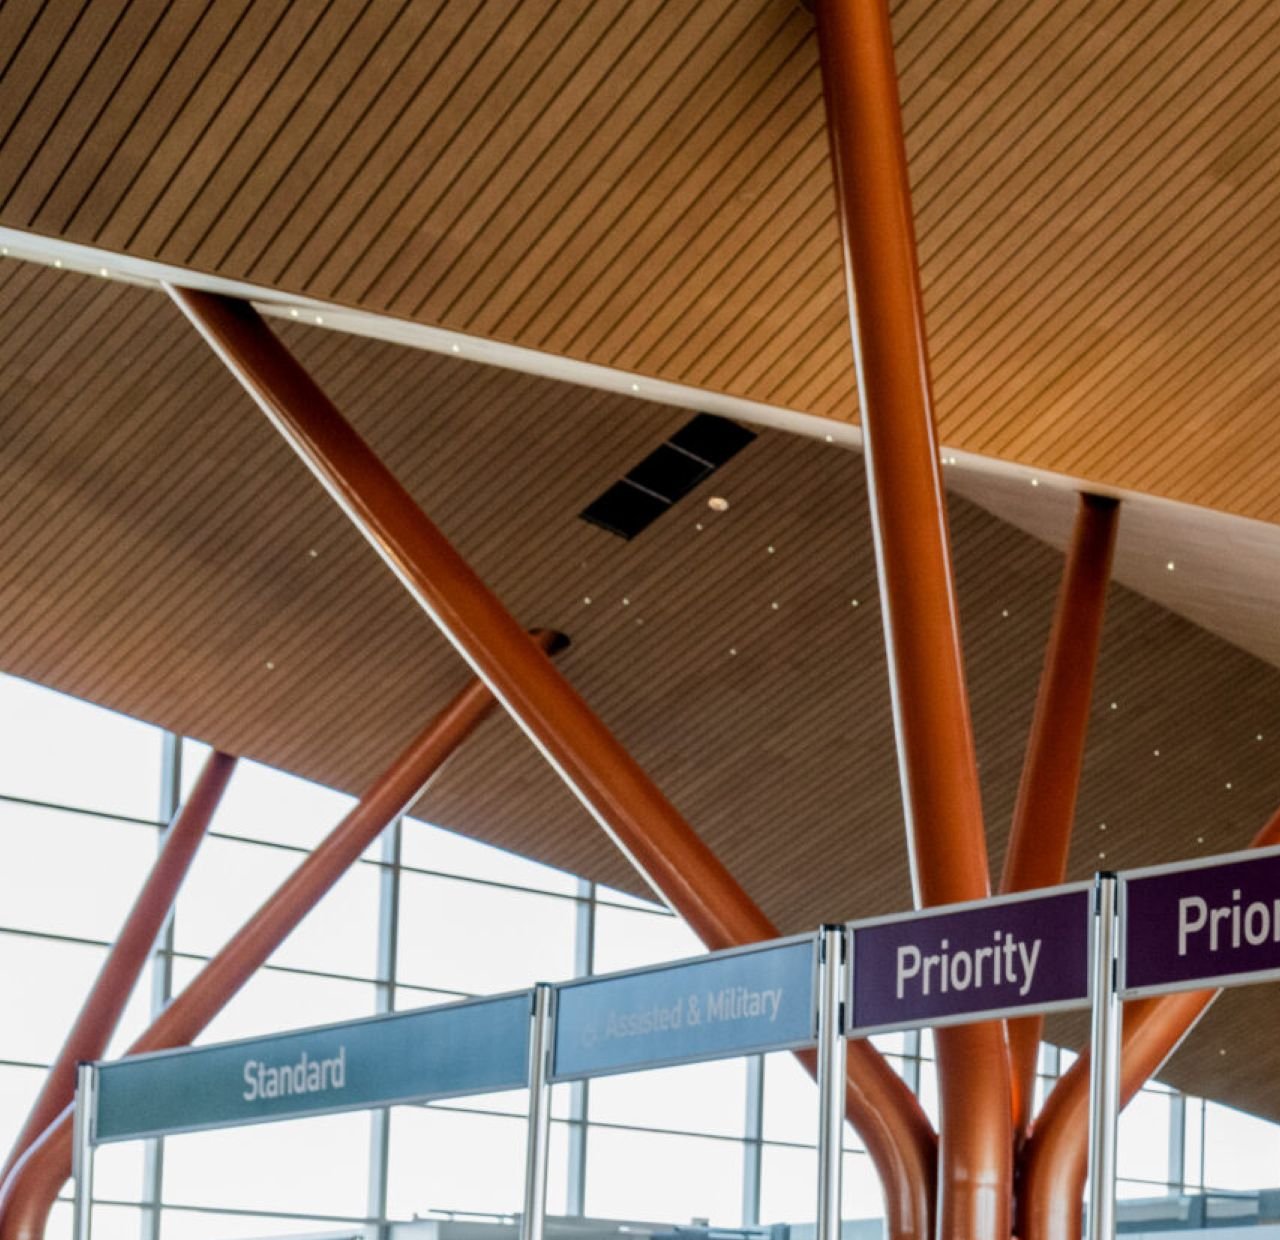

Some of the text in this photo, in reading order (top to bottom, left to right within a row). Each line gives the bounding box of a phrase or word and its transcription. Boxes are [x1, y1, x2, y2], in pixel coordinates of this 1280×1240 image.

[896, 930, 1042, 1000] Priority
[604, 986, 784, 1038] Assisted & Military
[243, 1045, 346, 1101] Standard
